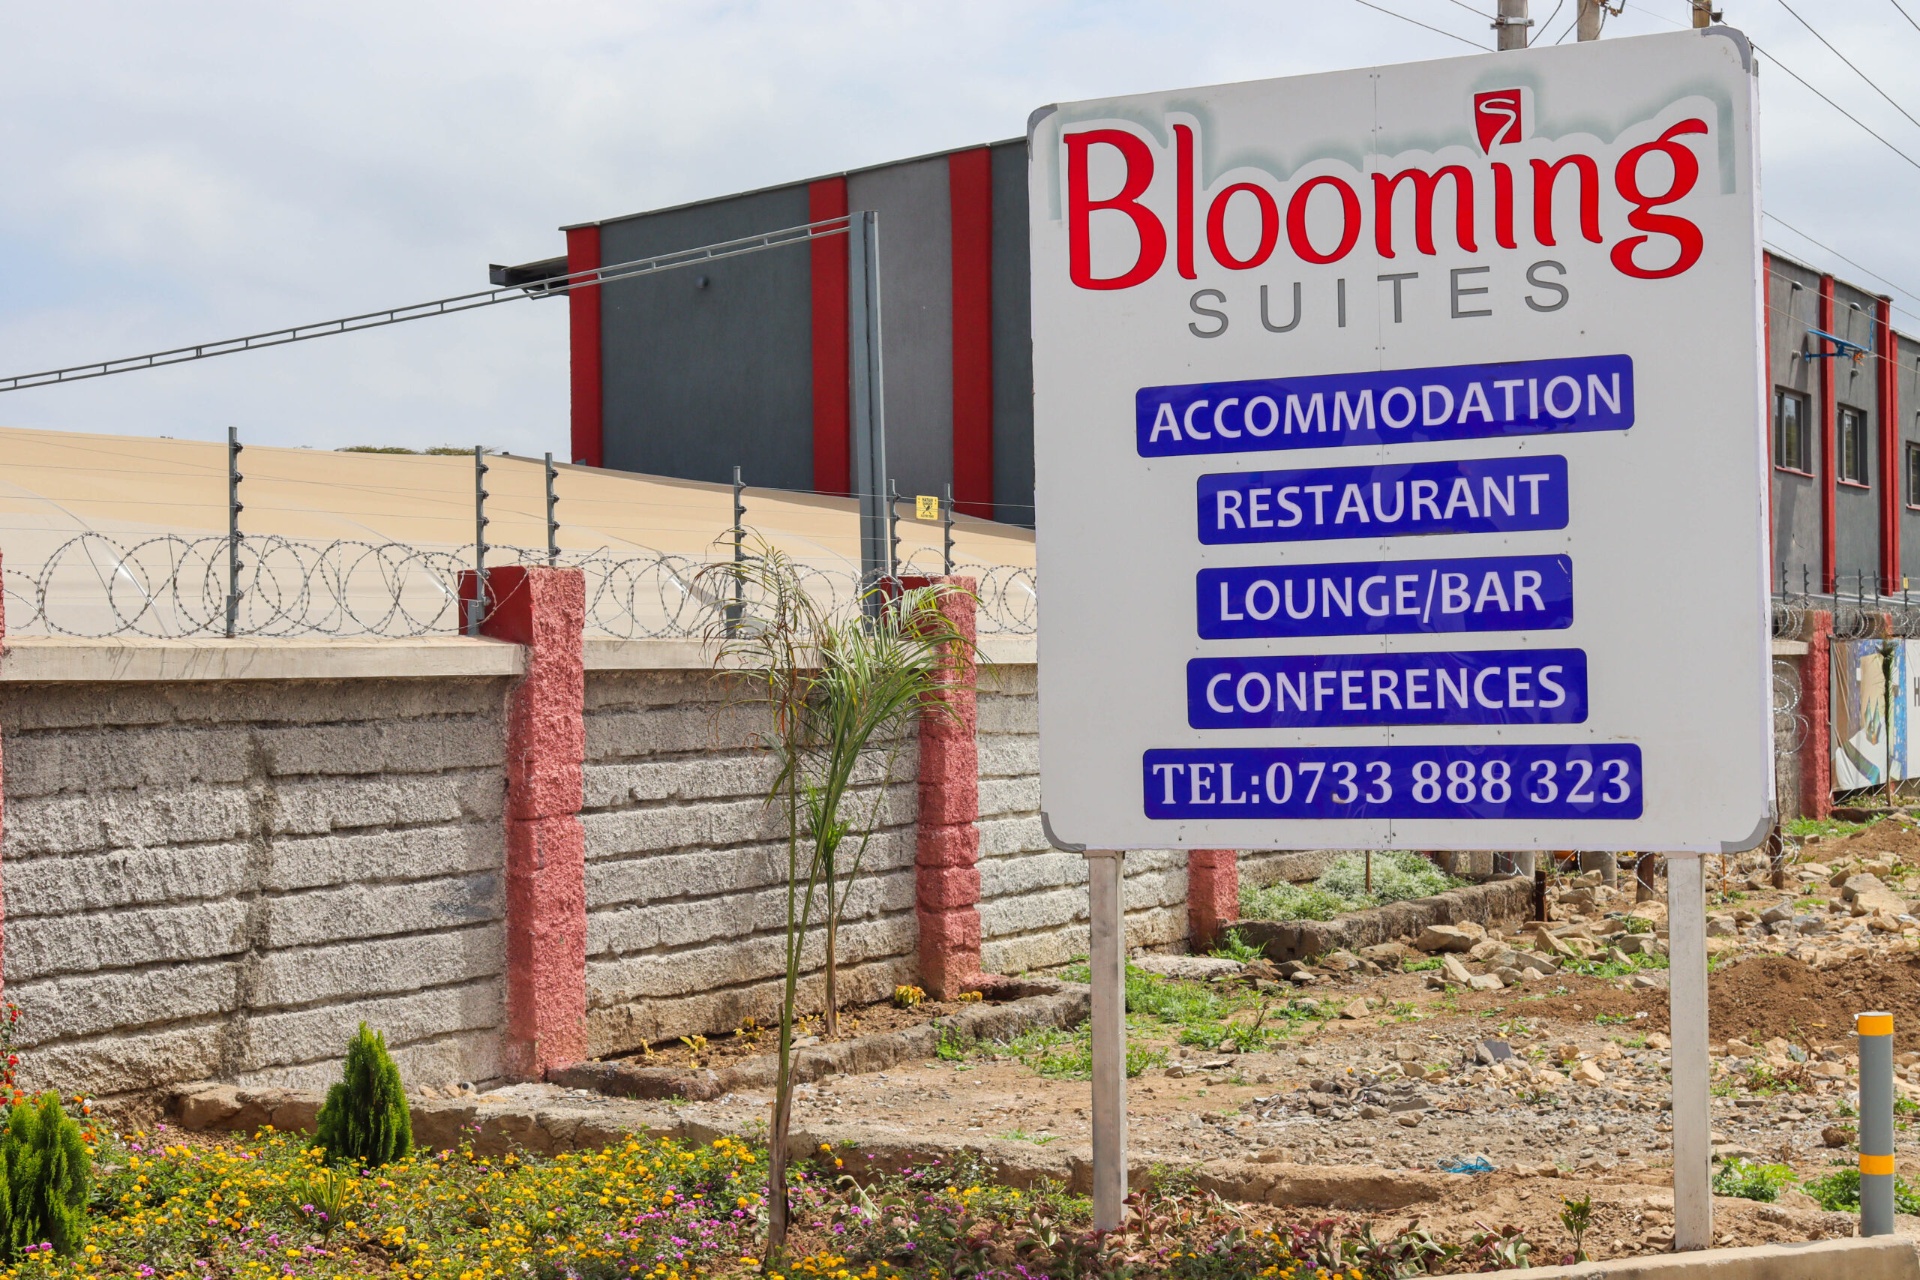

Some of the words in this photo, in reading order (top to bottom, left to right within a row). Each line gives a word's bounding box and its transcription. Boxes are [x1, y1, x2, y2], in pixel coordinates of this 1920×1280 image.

[1063, 88, 1709, 291] Blooming
[1187, 259, 1570, 339] SUITES
[1149, 372, 1622, 443] ACCOMMODATION
[1216, 473, 1550, 530] RESTAURANT
[1219, 569, 1546, 624] LOUNGE/BAR
[1205, 664, 1566, 714] CONFERENCES
[1152, 761, 1393, 806] TEL:0733
[1411, 760, 1512, 804] 888
[1530, 759, 1632, 804] 323
